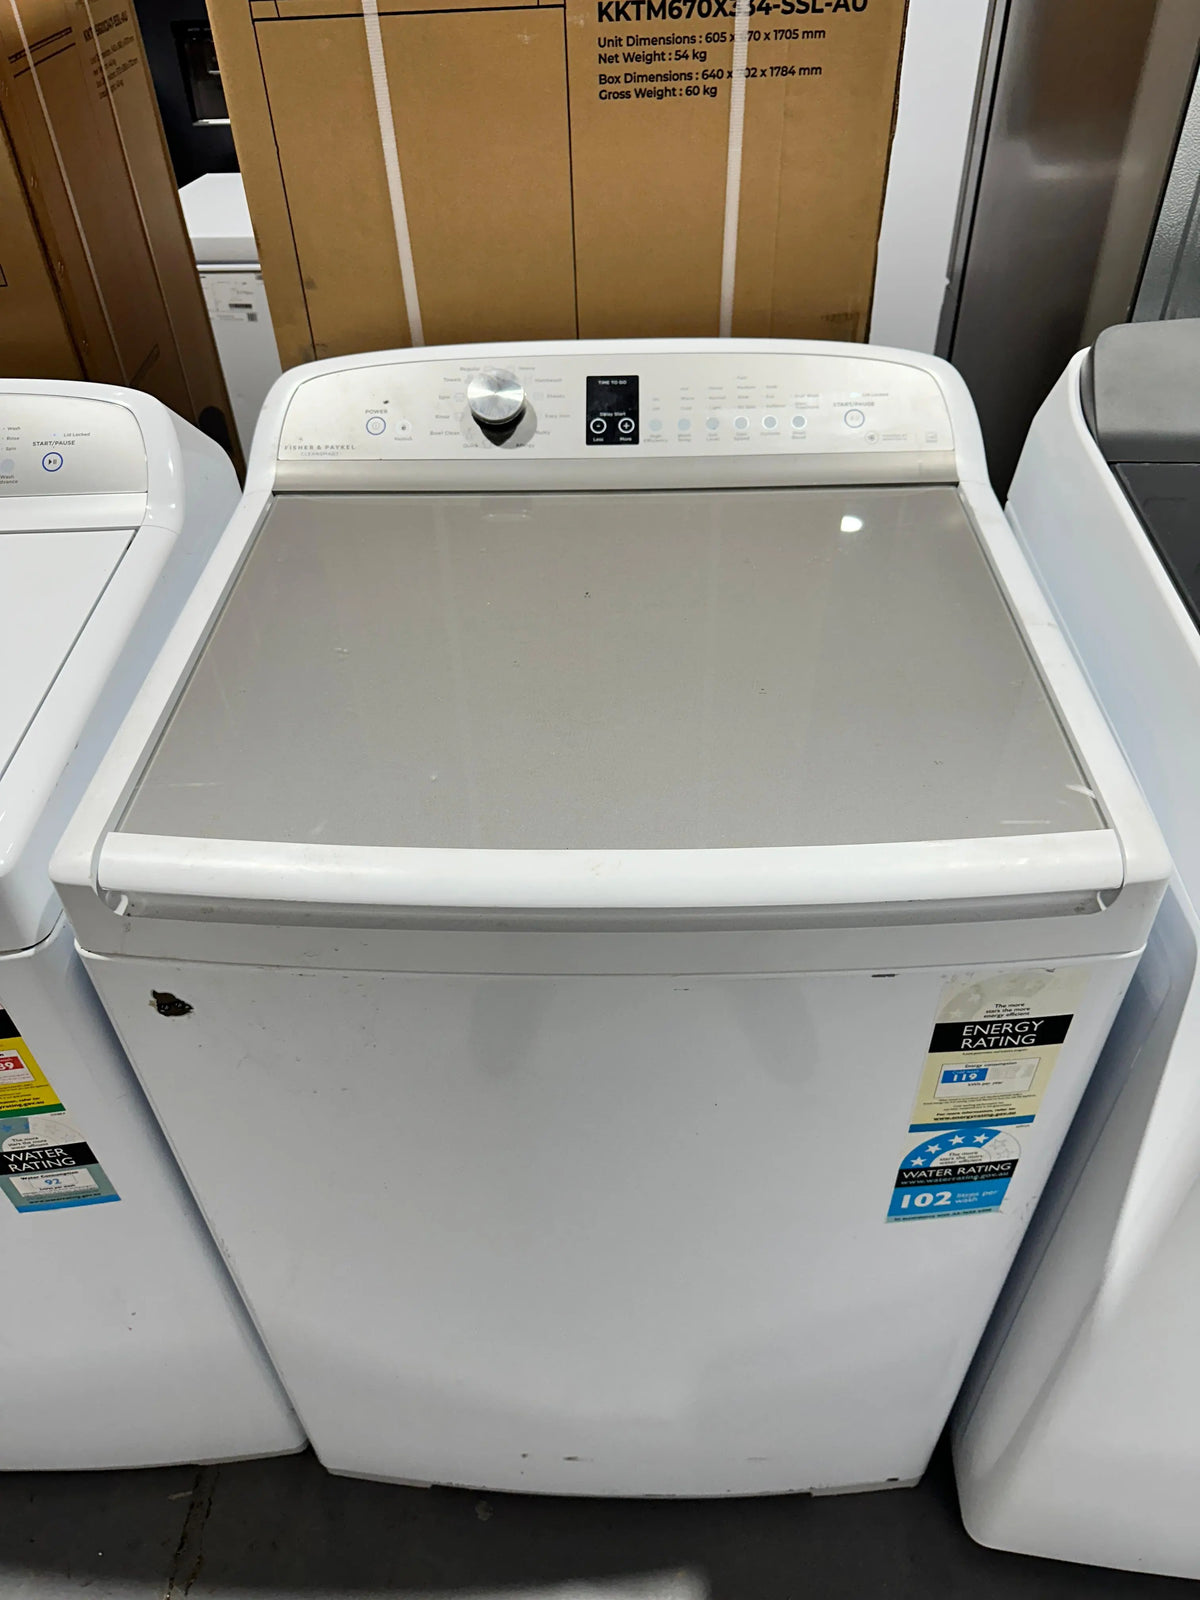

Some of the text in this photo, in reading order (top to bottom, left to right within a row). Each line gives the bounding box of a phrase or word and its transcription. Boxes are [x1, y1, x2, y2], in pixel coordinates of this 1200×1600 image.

[597, 29, 826, 48] Unit Dimensions : 605 x 70 x 1705 mm
[598, 49, 708, 65] Net Weight : 54 kg
[598, 66, 823, 85] Box Dimensions : 640 x 02 x 1784 mm
[598, 85, 718, 100] Gross Weight : 60 kg
[962, 1020, 1044, 1036] ENERGY
[960, 1033, 1037, 1049] RATING
[953, 1073, 978, 1082] 119
[933, 1111, 1017, 1121] www.energyrating.gov.au
[3, 1147, 68, 1162] WATER
[8, 1156, 76, 1172] RATING
[902, 1162, 1012, 1179] WATER RATING
[900, 1171, 1009, 1185] www.waterrating.gov.au
[900, 1190, 952, 1209] 102
